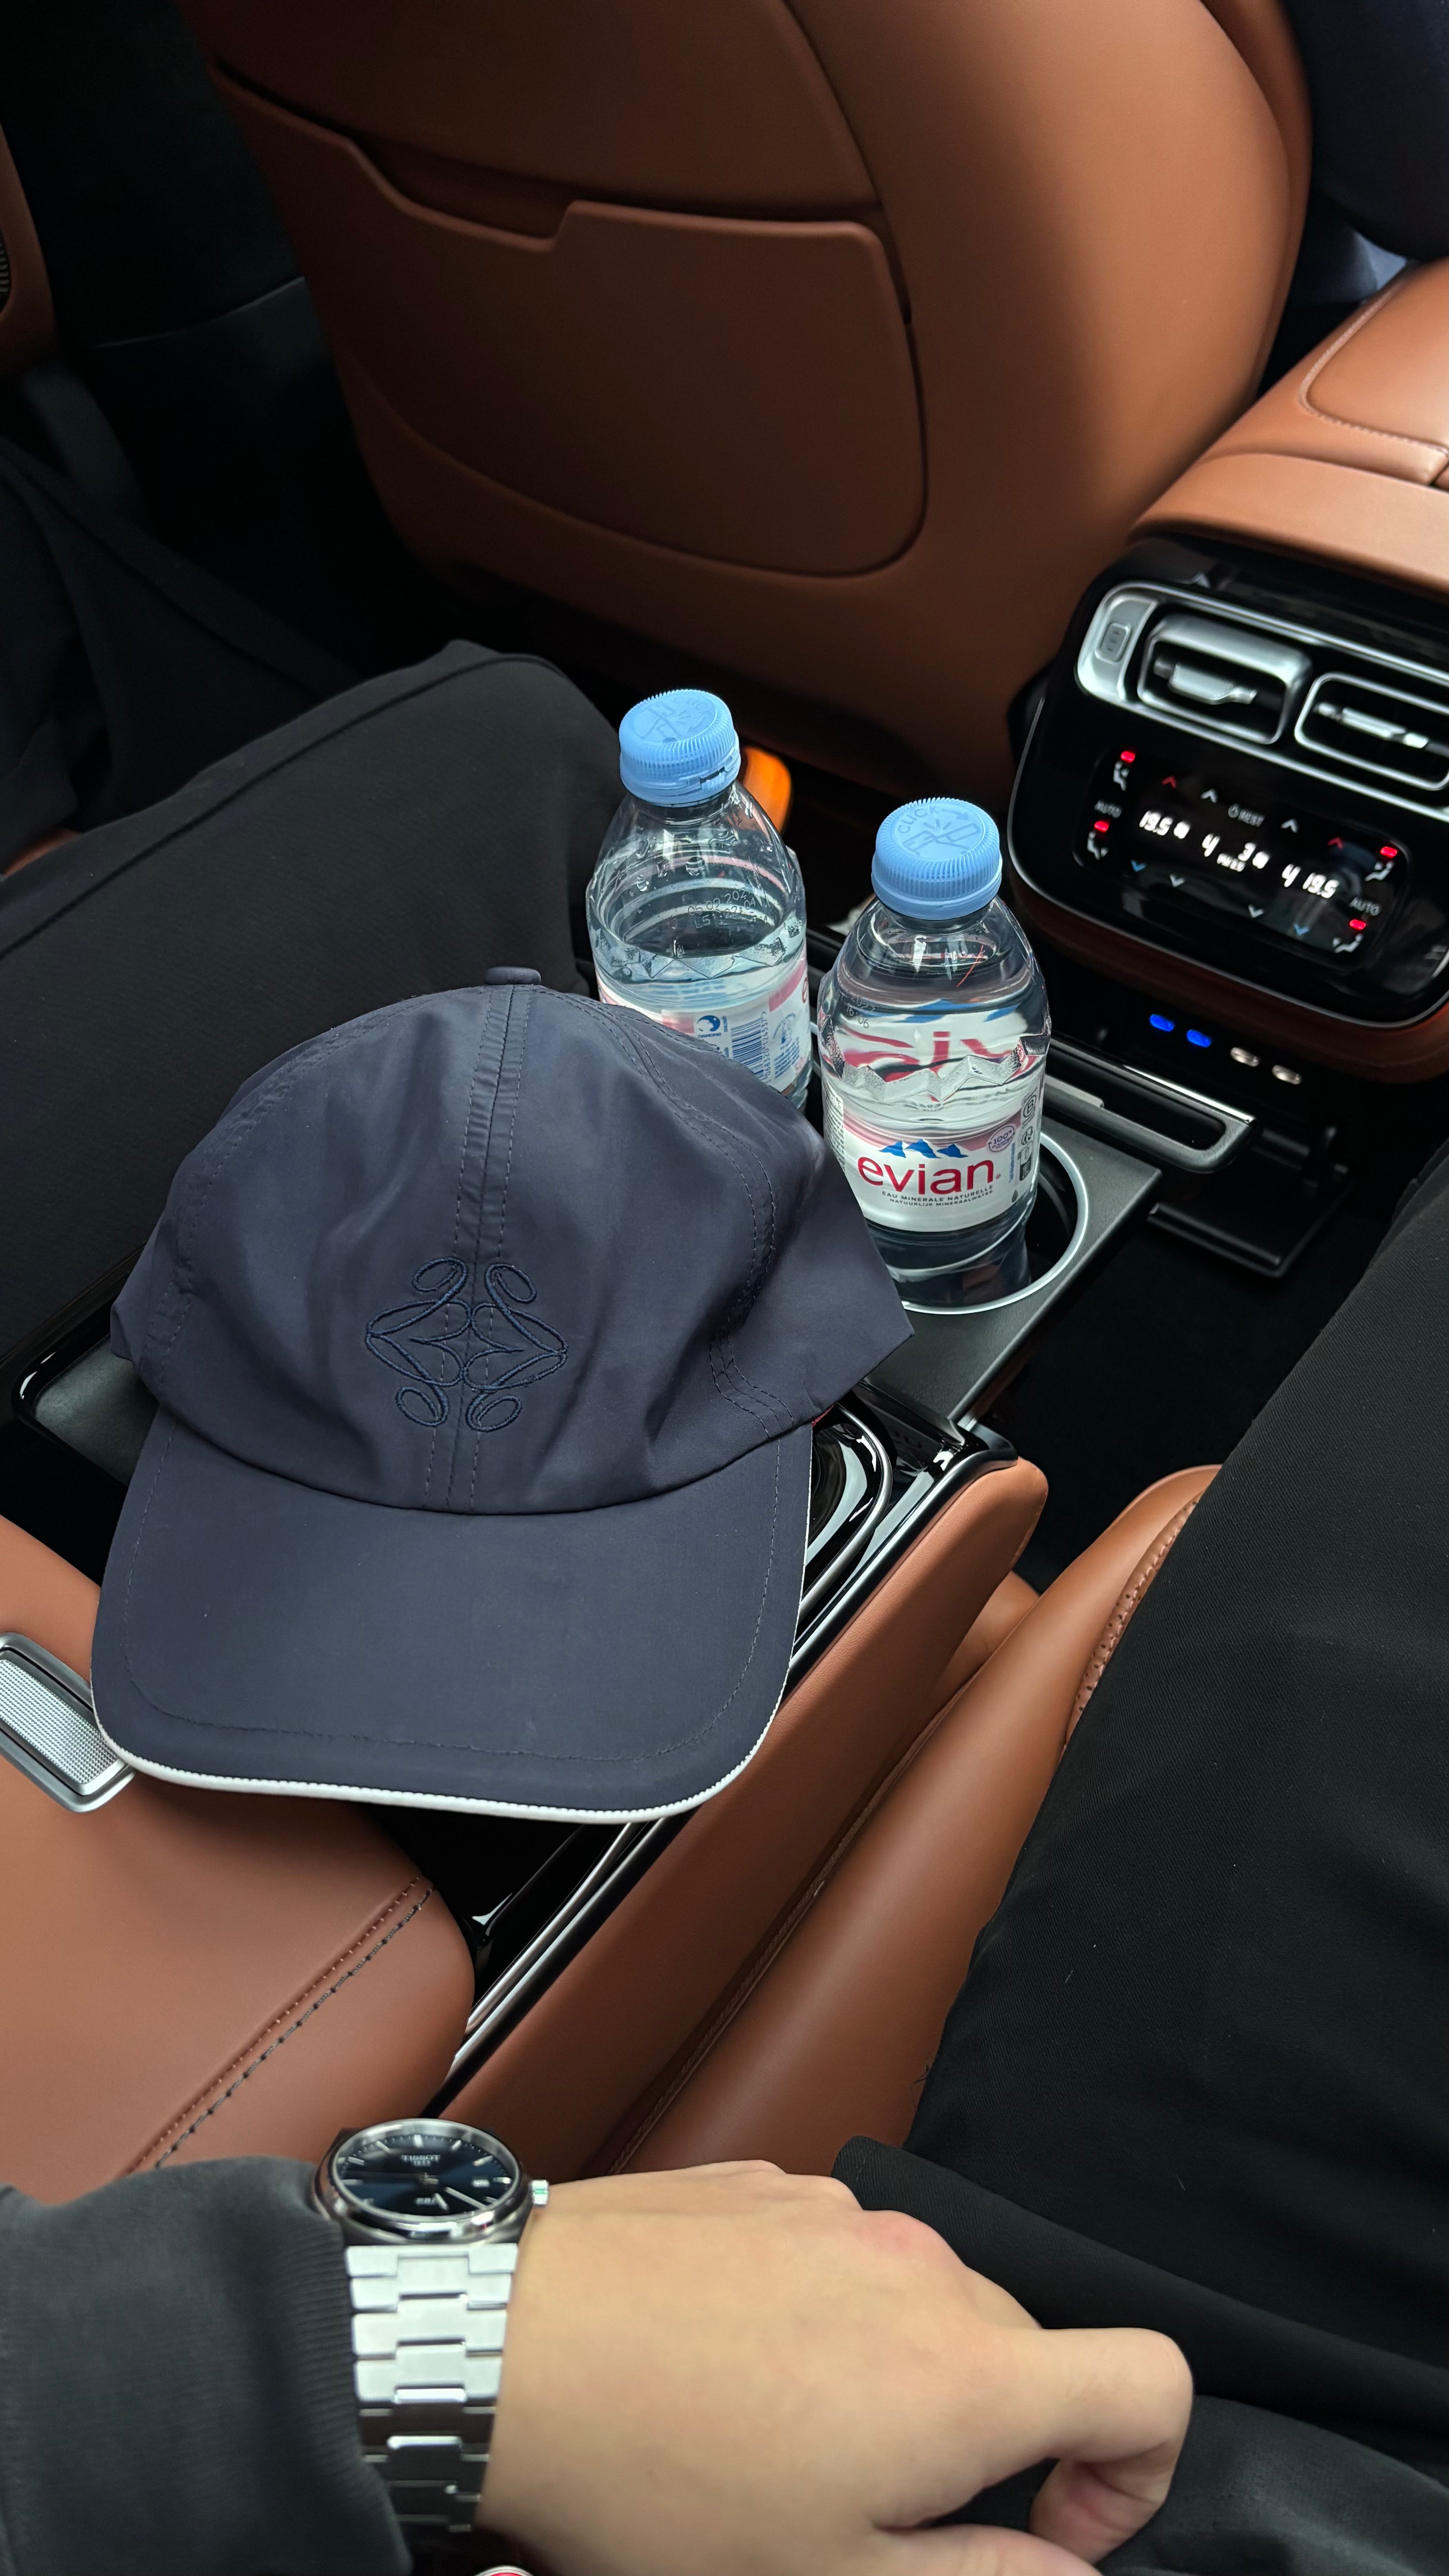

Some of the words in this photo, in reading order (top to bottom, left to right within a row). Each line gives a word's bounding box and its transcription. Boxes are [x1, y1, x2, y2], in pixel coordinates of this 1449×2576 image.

[897, 805, 940, 833] CLICK
[1095, 800, 1122, 818] AUTO
[1139, 811, 1173, 836] 19.5
[1202, 834, 1219, 857] 4
[1282, 864, 1301, 888] 4
[1302, 873, 1340, 898] 19.5
[1349, 897, 1381, 916] AUTO
[857, 1156, 994, 1196] evian
[936, 1190, 994, 1206] MINERAALWATER
[948, 1185, 993, 1201] NATURELLE
